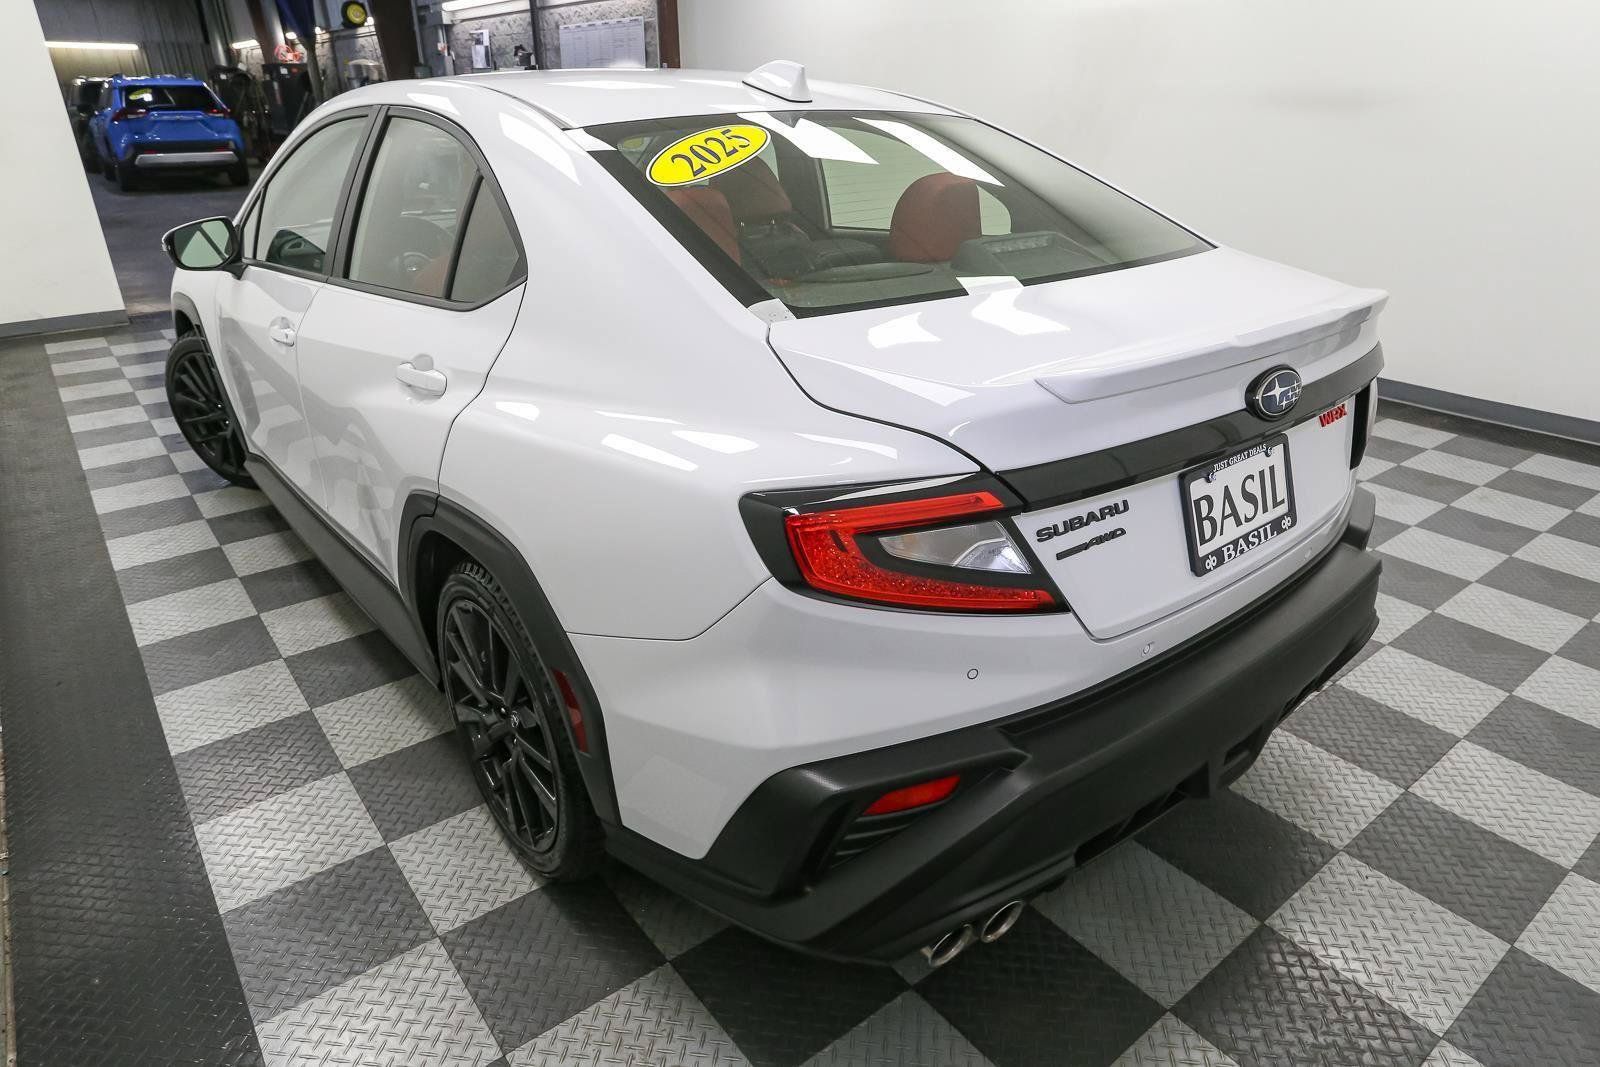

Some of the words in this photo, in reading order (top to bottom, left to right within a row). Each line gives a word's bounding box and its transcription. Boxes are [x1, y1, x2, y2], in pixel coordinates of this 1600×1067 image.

[671, 129, 750, 177] 2025
[1319, 403, 1347, 427] WRX
[1213, 460, 1228, 472] JUST
[1229, 451, 1248, 465] GREAT
[1249, 444, 1267, 457] DEALS
[1036, 499, 1130, 542] SUBARU
[1193, 464, 1285, 547] BASIL
[1085, 527, 1127, 550] AWD
[1222, 523, 1277, 563] BASIL
